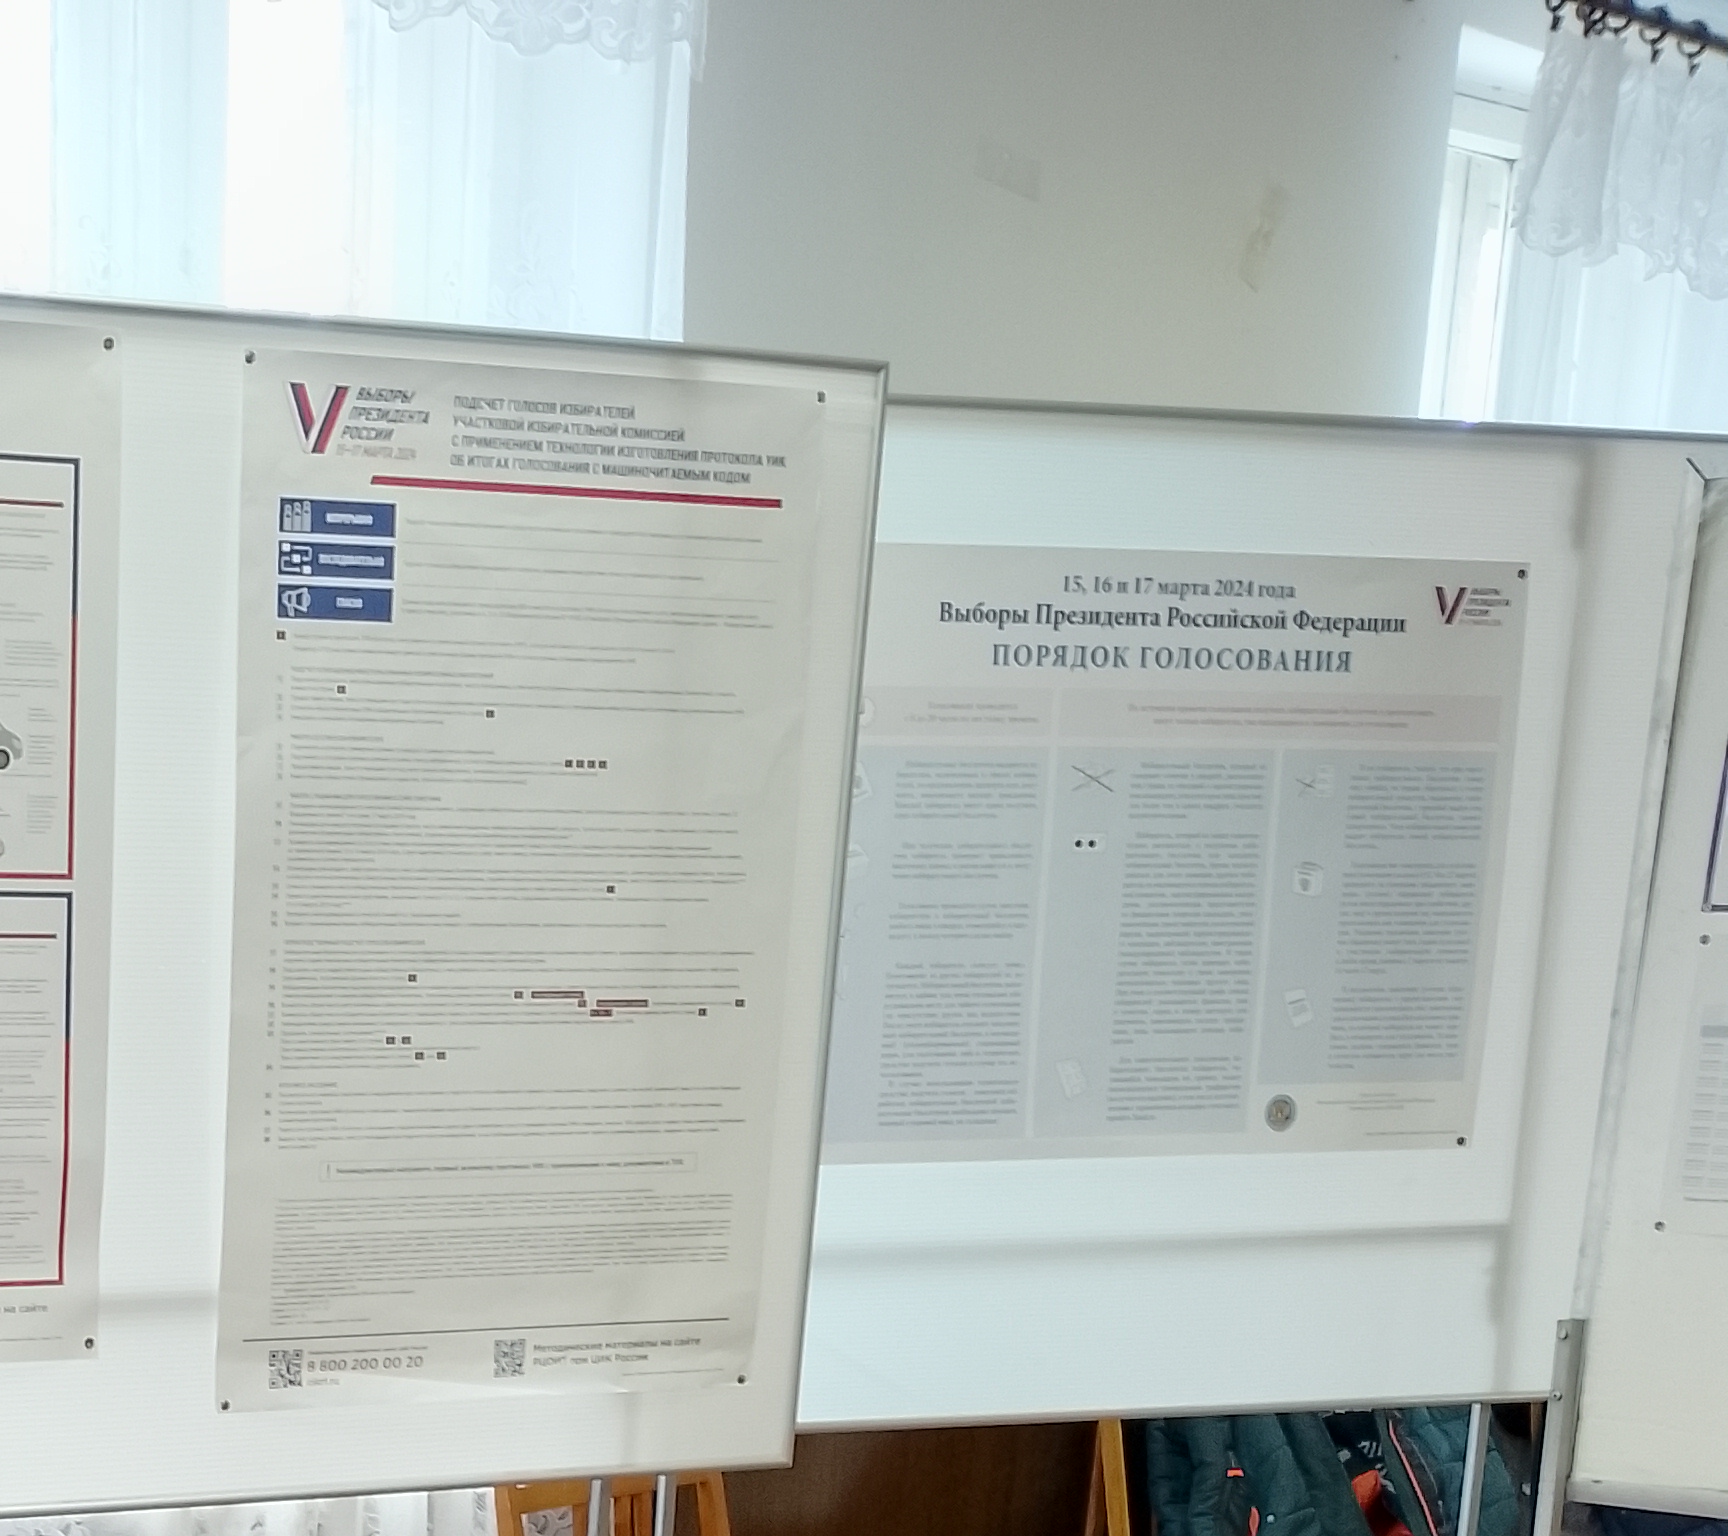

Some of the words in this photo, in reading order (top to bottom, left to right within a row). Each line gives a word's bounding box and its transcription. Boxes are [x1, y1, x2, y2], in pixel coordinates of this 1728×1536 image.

[355, 386, 416, 404] ВЫБОРЫ
[348, 405, 430, 425] ПРЕЗИДЕНТА
[340, 424, 395, 442] РОССИИ
[1063, 575, 1087, 595] 15,
[1093, 575, 1113, 594] 16
[1134, 576, 1154, 595] 17
[1157, 580, 1210, 601] марта
[1214, 578, 1254, 597] 2024
[1258, 583, 1297, 599] года
[939, 600, 1030, 631] Выборы
[1035, 602, 1161, 632] Президента
[1167, 605, 1288, 630] Российской
[1292, 608, 1407, 638] Федерации
[992, 643, 1130, 672] ПОРЯДОК
[1139, 646, 1353, 674] ГОЛОСОВАНИЯ
[307, 1360, 315, 1373] 8
[319, 1359, 347, 1372] 800
[351, 1358, 379, 1370] 200
[383, 1357, 402, 1369] 00
[406, 1356, 424, 1368] 20
